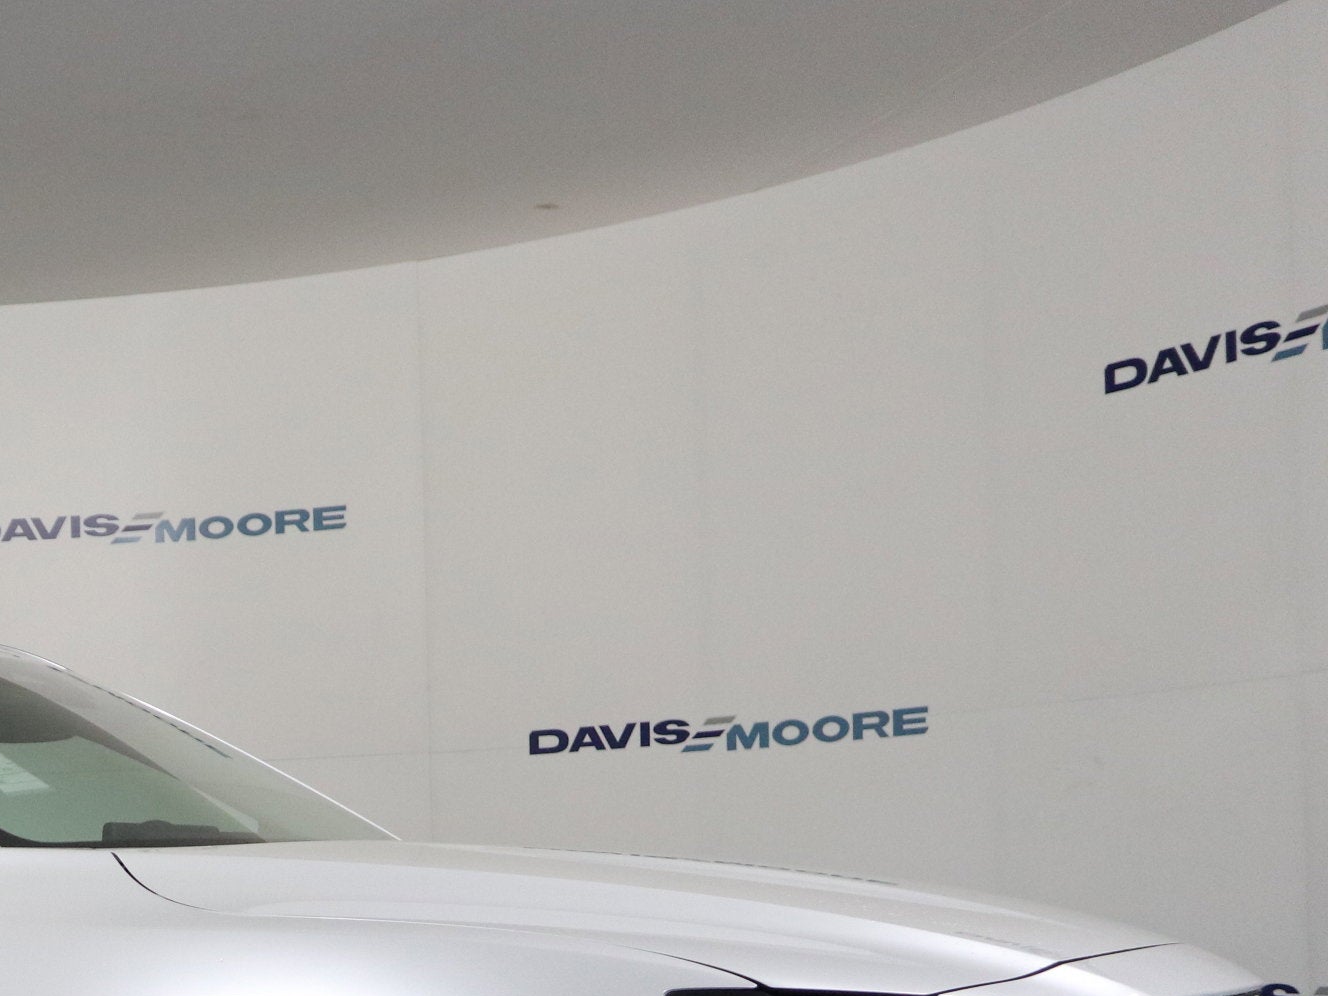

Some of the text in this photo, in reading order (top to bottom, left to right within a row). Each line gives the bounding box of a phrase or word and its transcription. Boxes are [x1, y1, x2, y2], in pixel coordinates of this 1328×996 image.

[1104, 320, 1282, 395] DAVIS
[154, 504, 347, 544] MOORE
[529, 706, 929, 755] DAVIS MOORE
